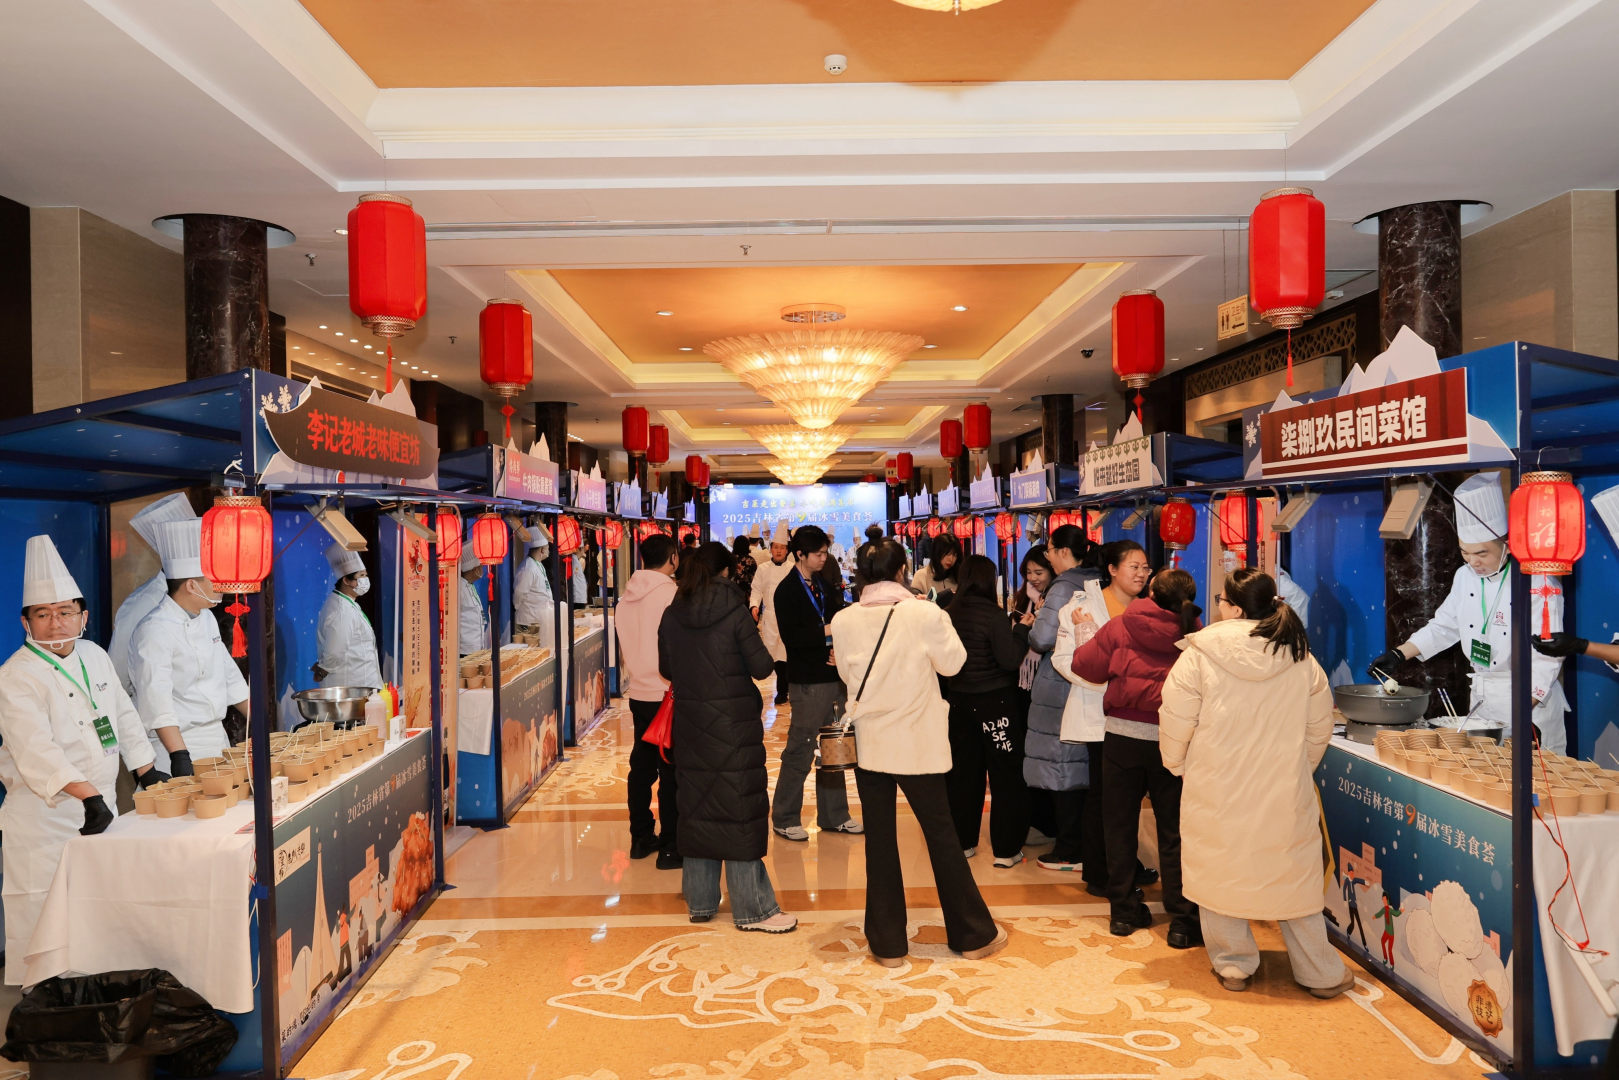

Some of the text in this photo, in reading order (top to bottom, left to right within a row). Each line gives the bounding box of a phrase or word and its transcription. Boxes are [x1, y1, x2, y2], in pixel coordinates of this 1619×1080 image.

[307, 408, 421, 466] 李记老城老味便宜坊
[1282, 395, 1427, 458] 柒捌玖民间菜馆
[1338, 776, 1497, 866] 2025吉林省第9届冰雪美食荟
